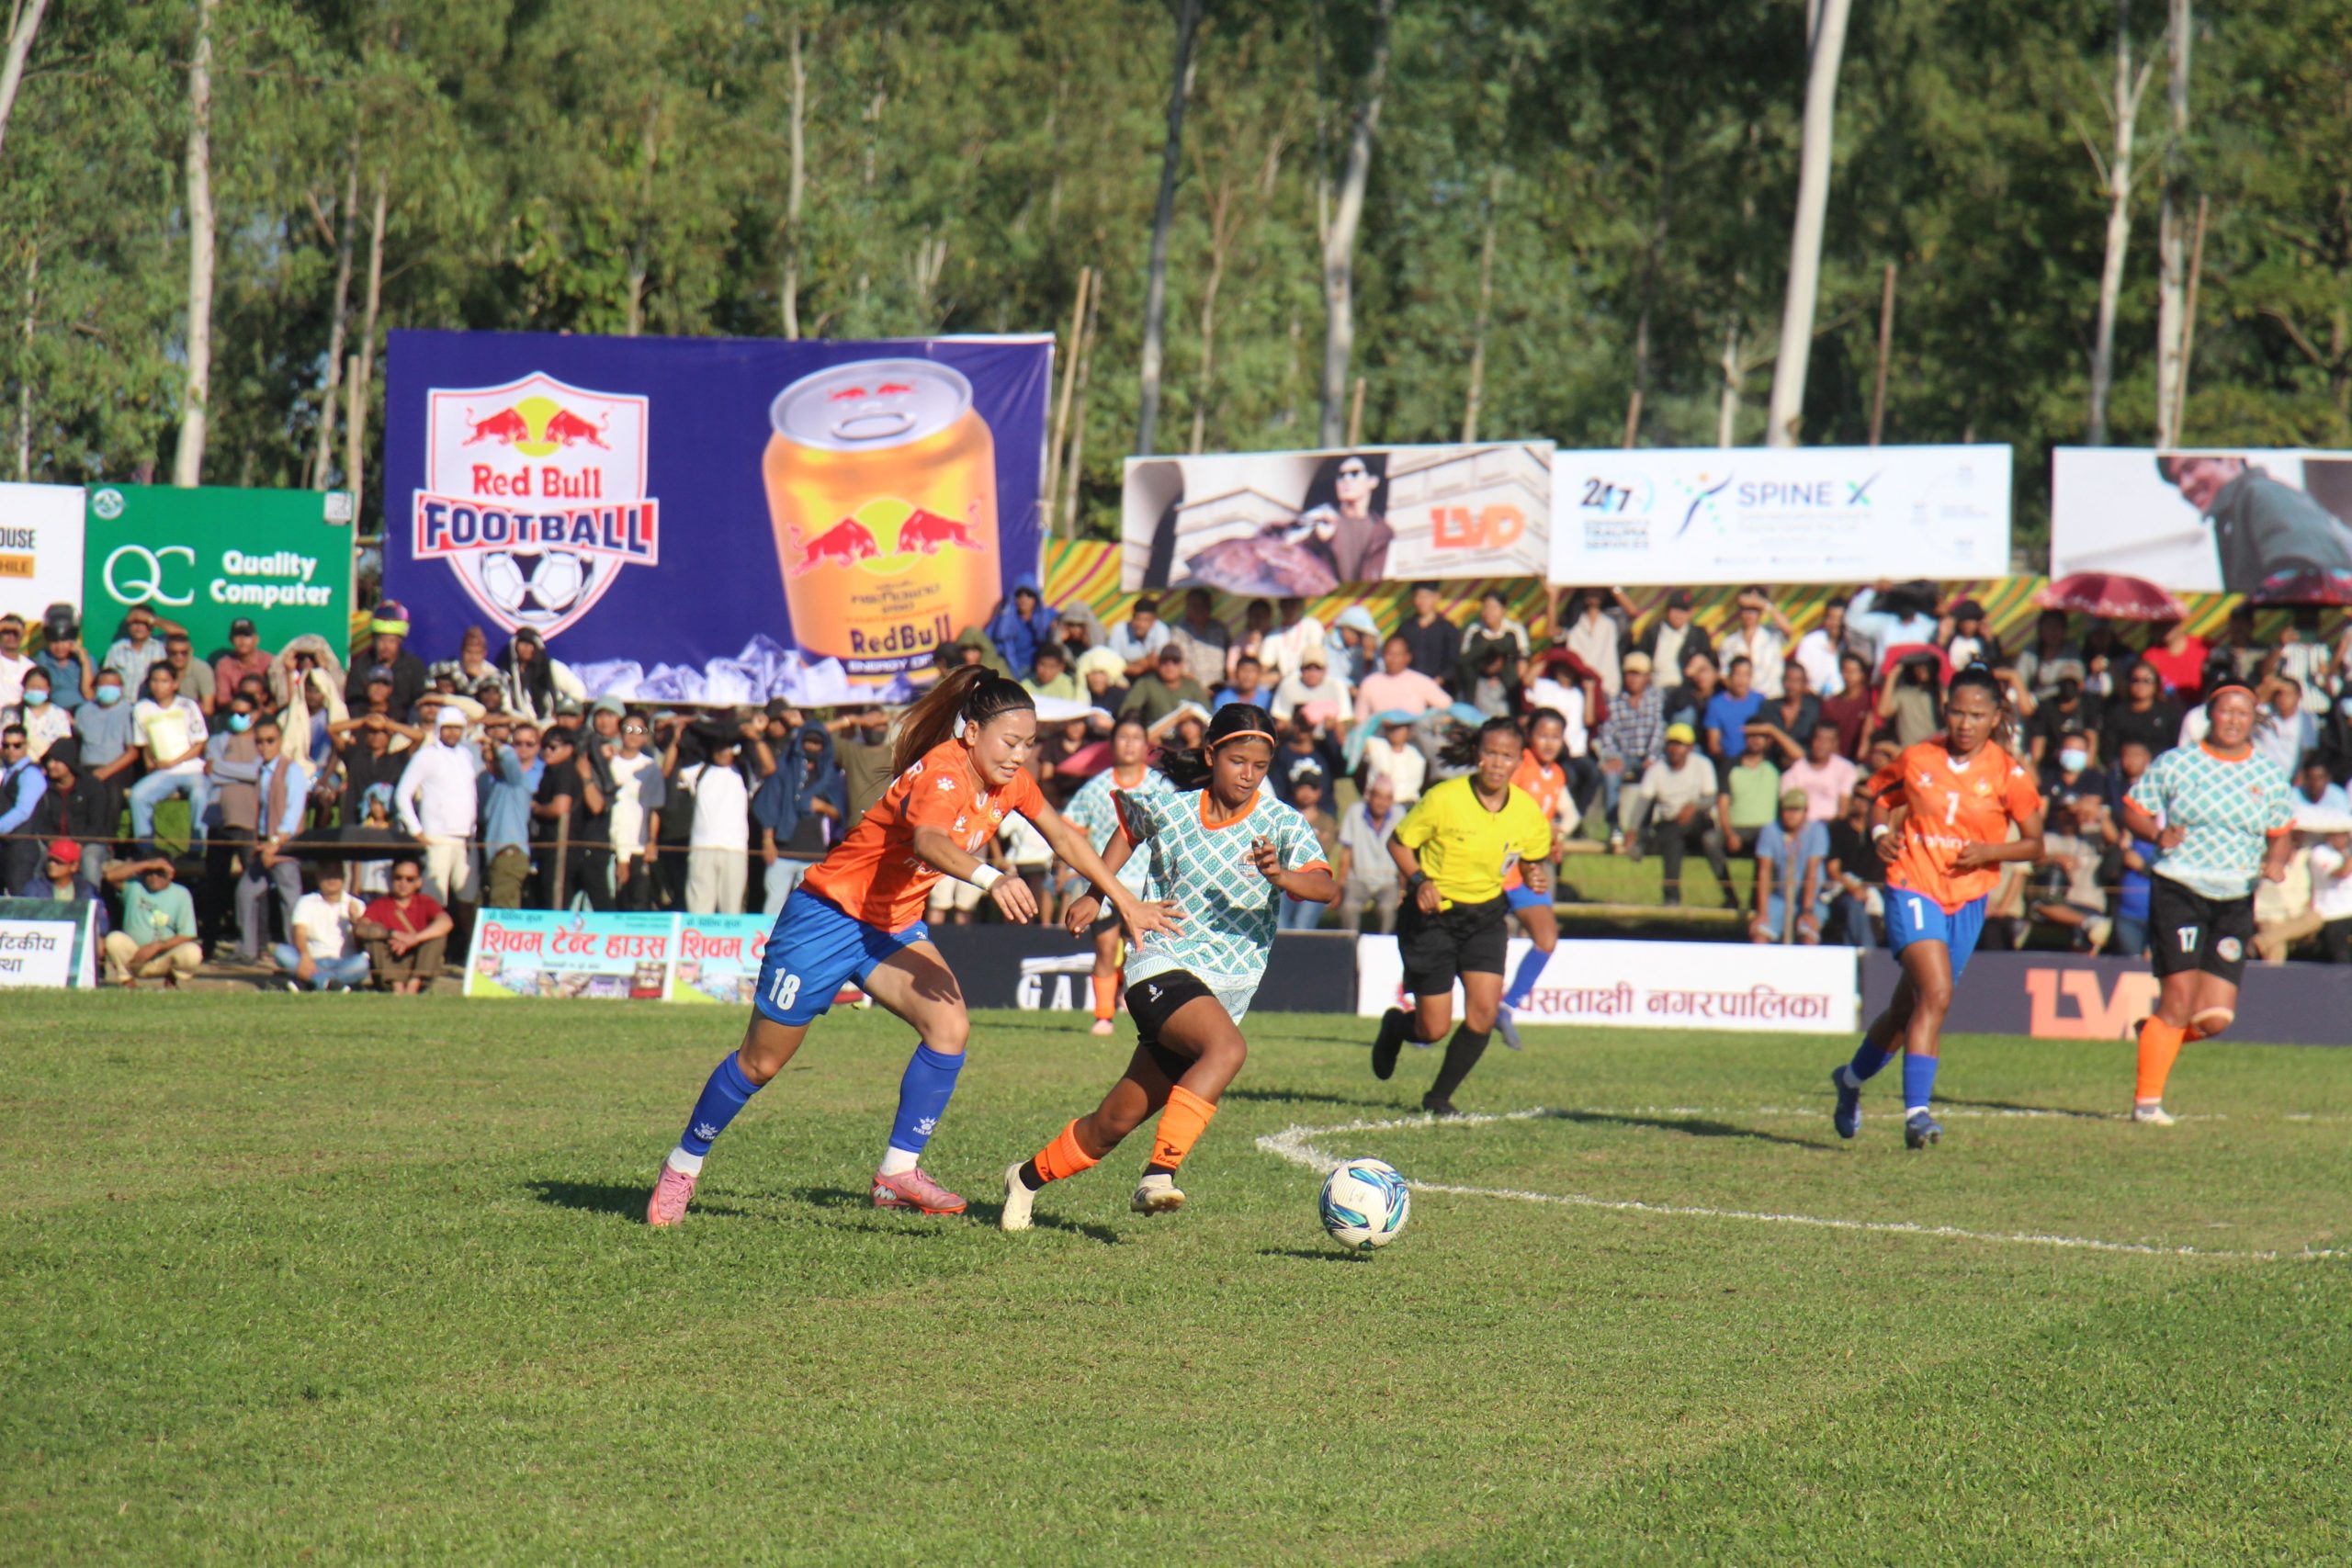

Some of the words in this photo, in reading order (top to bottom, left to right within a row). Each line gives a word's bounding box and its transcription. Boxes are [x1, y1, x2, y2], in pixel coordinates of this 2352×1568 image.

[472, 463, 531, 496] Red
[542, 467, 602, 499] Bull
[1738, 480, 1833, 507] SPINE
[424, 501, 649, 555] FOOTBALL
[103, 545, 195, 606] QC
[222, 550, 318, 582] Quality
[209, 578, 332, 608] Computer
[1908, 897, 1925, 931] 1
[2177, 926, 2199, 953] 17
[769, 967, 800, 1010] 18
